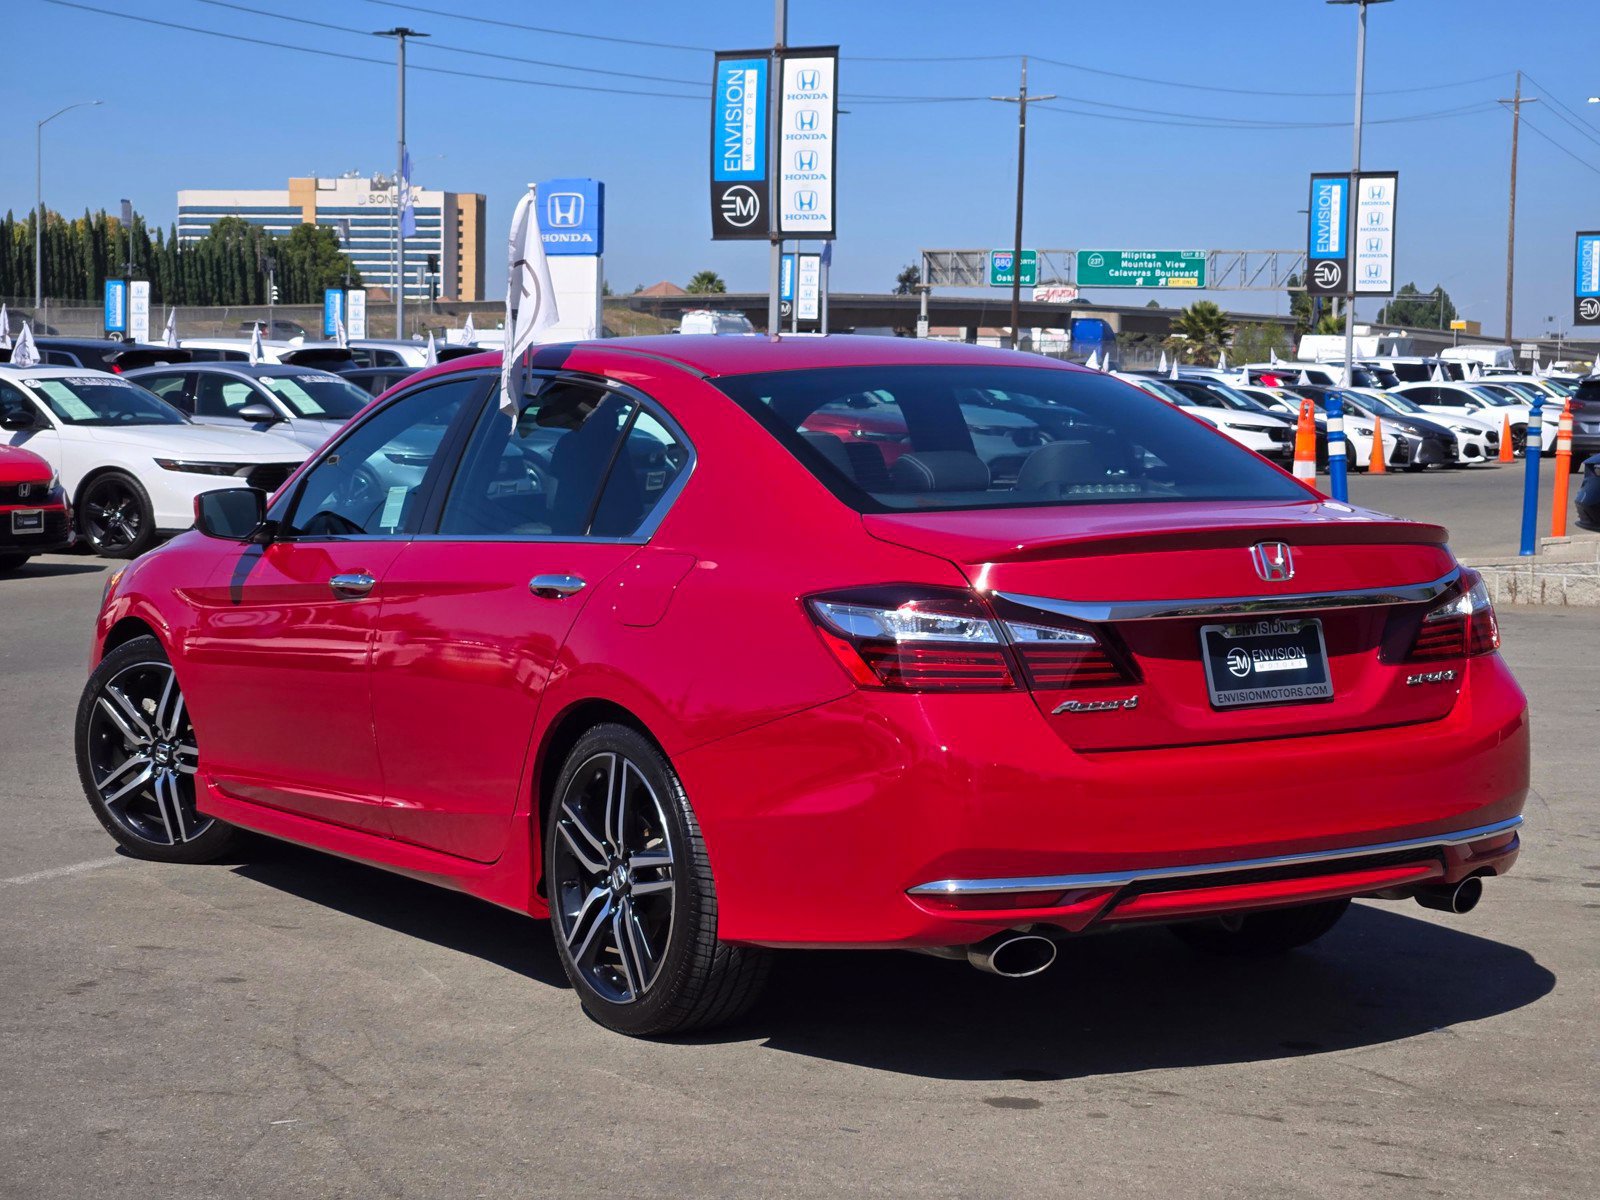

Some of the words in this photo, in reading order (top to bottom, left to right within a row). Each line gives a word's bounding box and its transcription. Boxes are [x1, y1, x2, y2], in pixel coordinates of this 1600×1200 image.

[724, 69, 745, 171] ENVISION
[745, 78, 755, 162] MOTORS
[369, 194, 420, 204] SONEA
[785, 213, 827, 221] HONDA
[1316, 184, 1332, 253] ENVISION
[541, 233, 593, 243] HONDA
[1121, 251, 1157, 260] Milpitas
[995, 258, 1011, 267] 880
[1121, 260, 1161, 268] Mountain
[1165, 260, 1186, 268] View
[1581, 239, 1592, 293] ENVISION
[996, 274, 1030, 282] Oaklnd
[1108, 269, 1152, 277] Calaveras
[1155, 269, 1199, 277] Boulevard
[1235, 621, 1288, 636] ENVISION
[1251, 646, 1306, 662] ENVISION
[1217, 685, 1328, 704] ENVISIONMOTORS.COM
[1051, 695, 1139, 714] Accord
